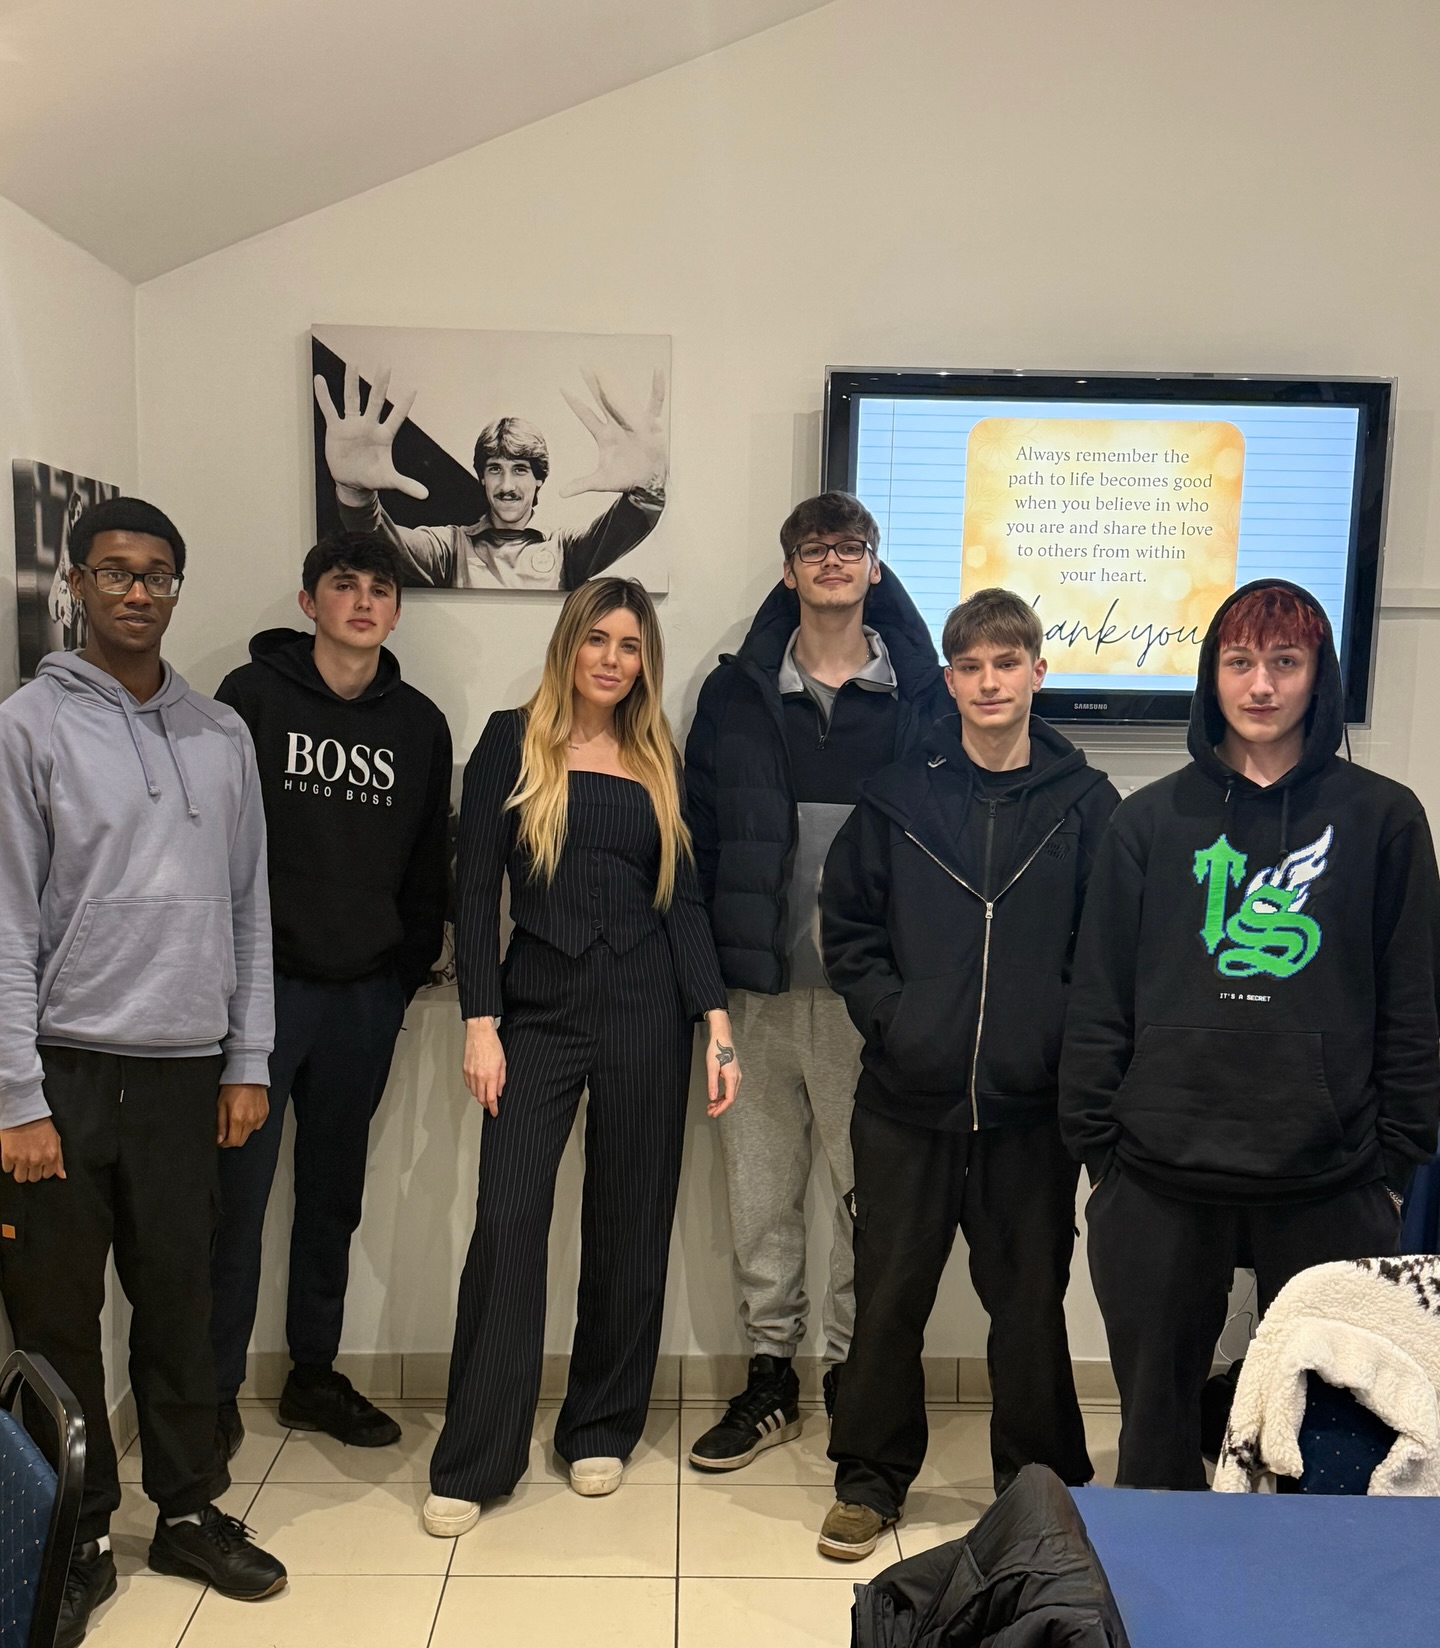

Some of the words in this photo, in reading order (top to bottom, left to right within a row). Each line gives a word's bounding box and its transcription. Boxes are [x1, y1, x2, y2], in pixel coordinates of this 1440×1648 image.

[1016, 446, 1071, 466] Always
[1076, 448, 1158, 463] remember
[1164, 449, 1190, 463] the
[1008, 471, 1044, 488] path
[1050, 472, 1066, 486] to
[1070, 472, 1094, 486] life
[1100, 472, 1169, 487] becomes
[1173, 474, 1212, 491] good
[1015, 495, 1056, 510] when
[1061, 499, 1090, 514] you
[1096, 496, 1151, 511] believe
[1156, 498, 1170, 512] in
[1176, 498, 1209, 512] who
[1006, 522, 1035, 536] you
[1040, 523, 1065, 534] are
[1069, 520, 1098, 534] and
[1103, 520, 1147, 535] share
[1151, 521, 1177, 535] the
[1181, 521, 1213, 536] love
[1018, 544, 1033, 557] to
[1038, 543, 1088, 558] others
[1092, 544, 1130, 558] from
[1136, 545, 1186, 559] within
[1060, 571, 1096, 585] your
[1101, 568, 1147, 583] heart.
[284, 732, 395, 790] BOSS
[284, 779, 332, 797] HUGO
[346, 789, 393, 807] BOSS
[1220, 992, 1236, 1000] IT'S
[1246, 994, 1271, 1003] SECRET
